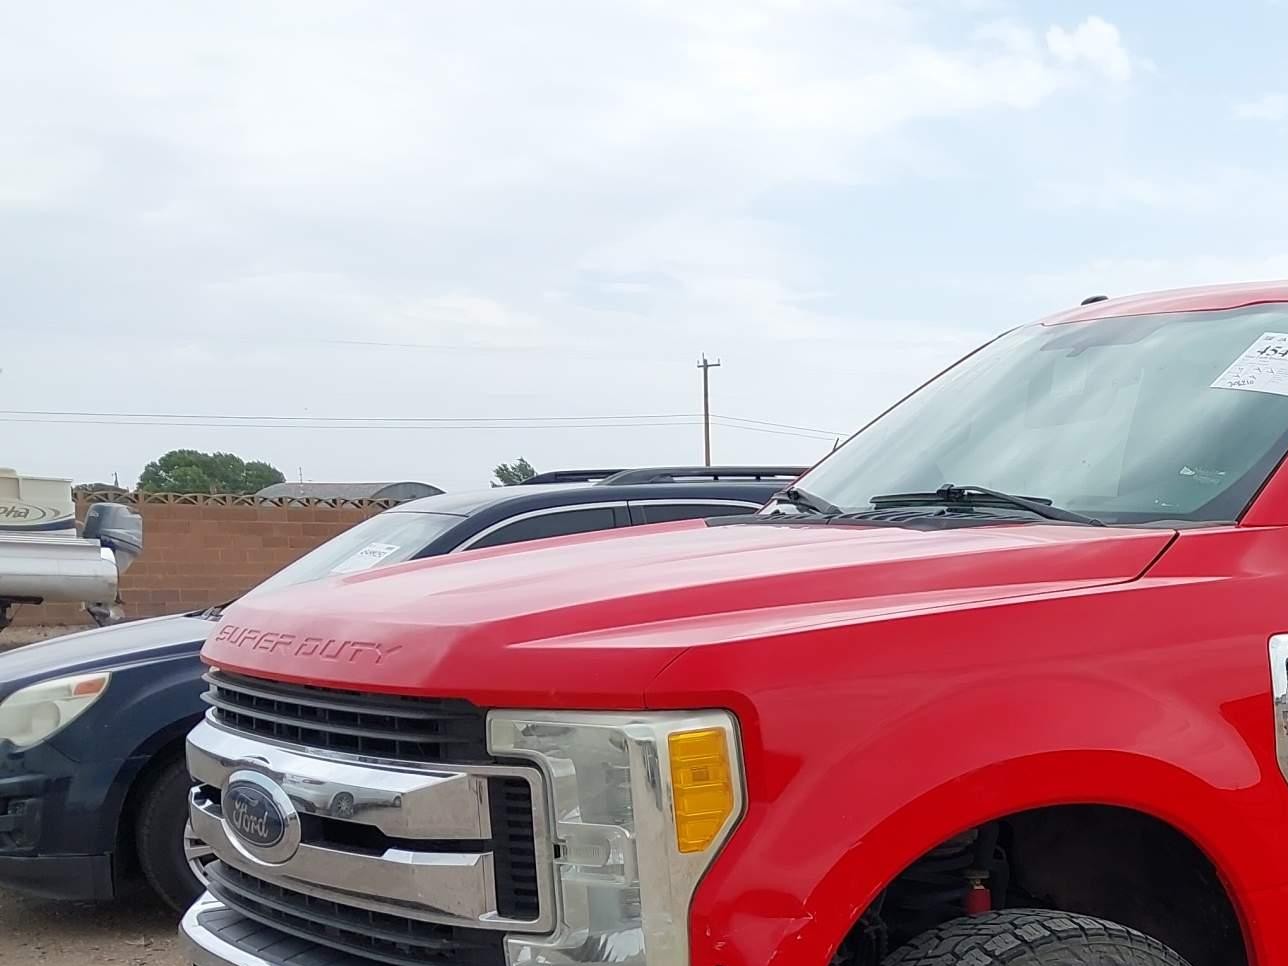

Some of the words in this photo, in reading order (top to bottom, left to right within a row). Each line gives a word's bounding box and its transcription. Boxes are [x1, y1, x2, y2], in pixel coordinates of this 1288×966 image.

[215, 624, 296, 654] SUPER
[294, 637, 403, 664] DUTY
[232, 793, 269, 838] Ford
